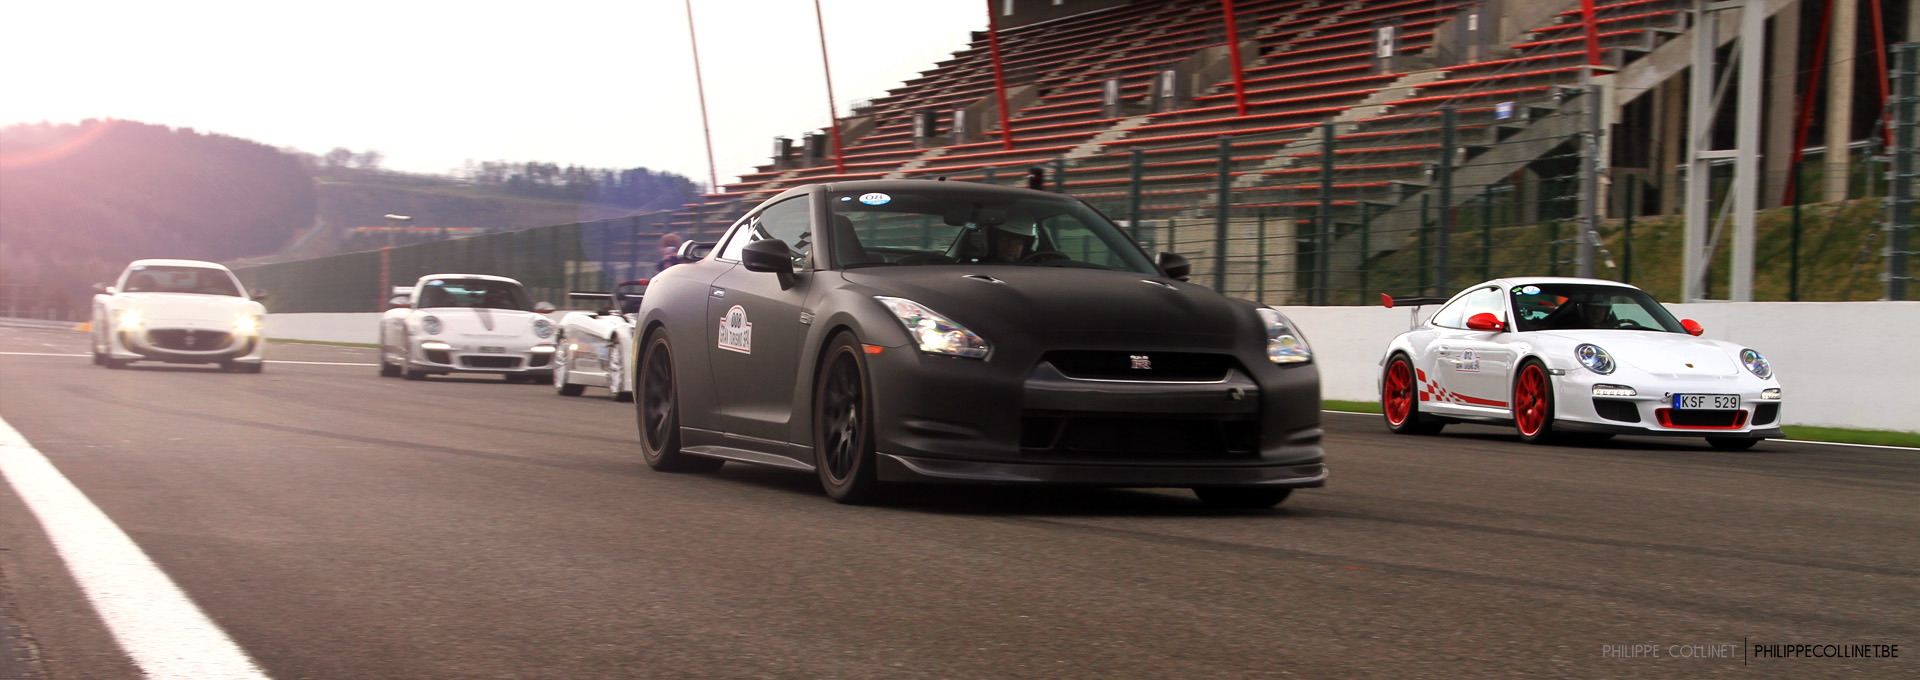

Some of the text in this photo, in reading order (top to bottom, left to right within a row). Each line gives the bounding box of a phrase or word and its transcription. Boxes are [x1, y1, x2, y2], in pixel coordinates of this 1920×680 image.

[731, 312, 742, 328] 008
[1681, 396, 1737, 409] KSF 529
